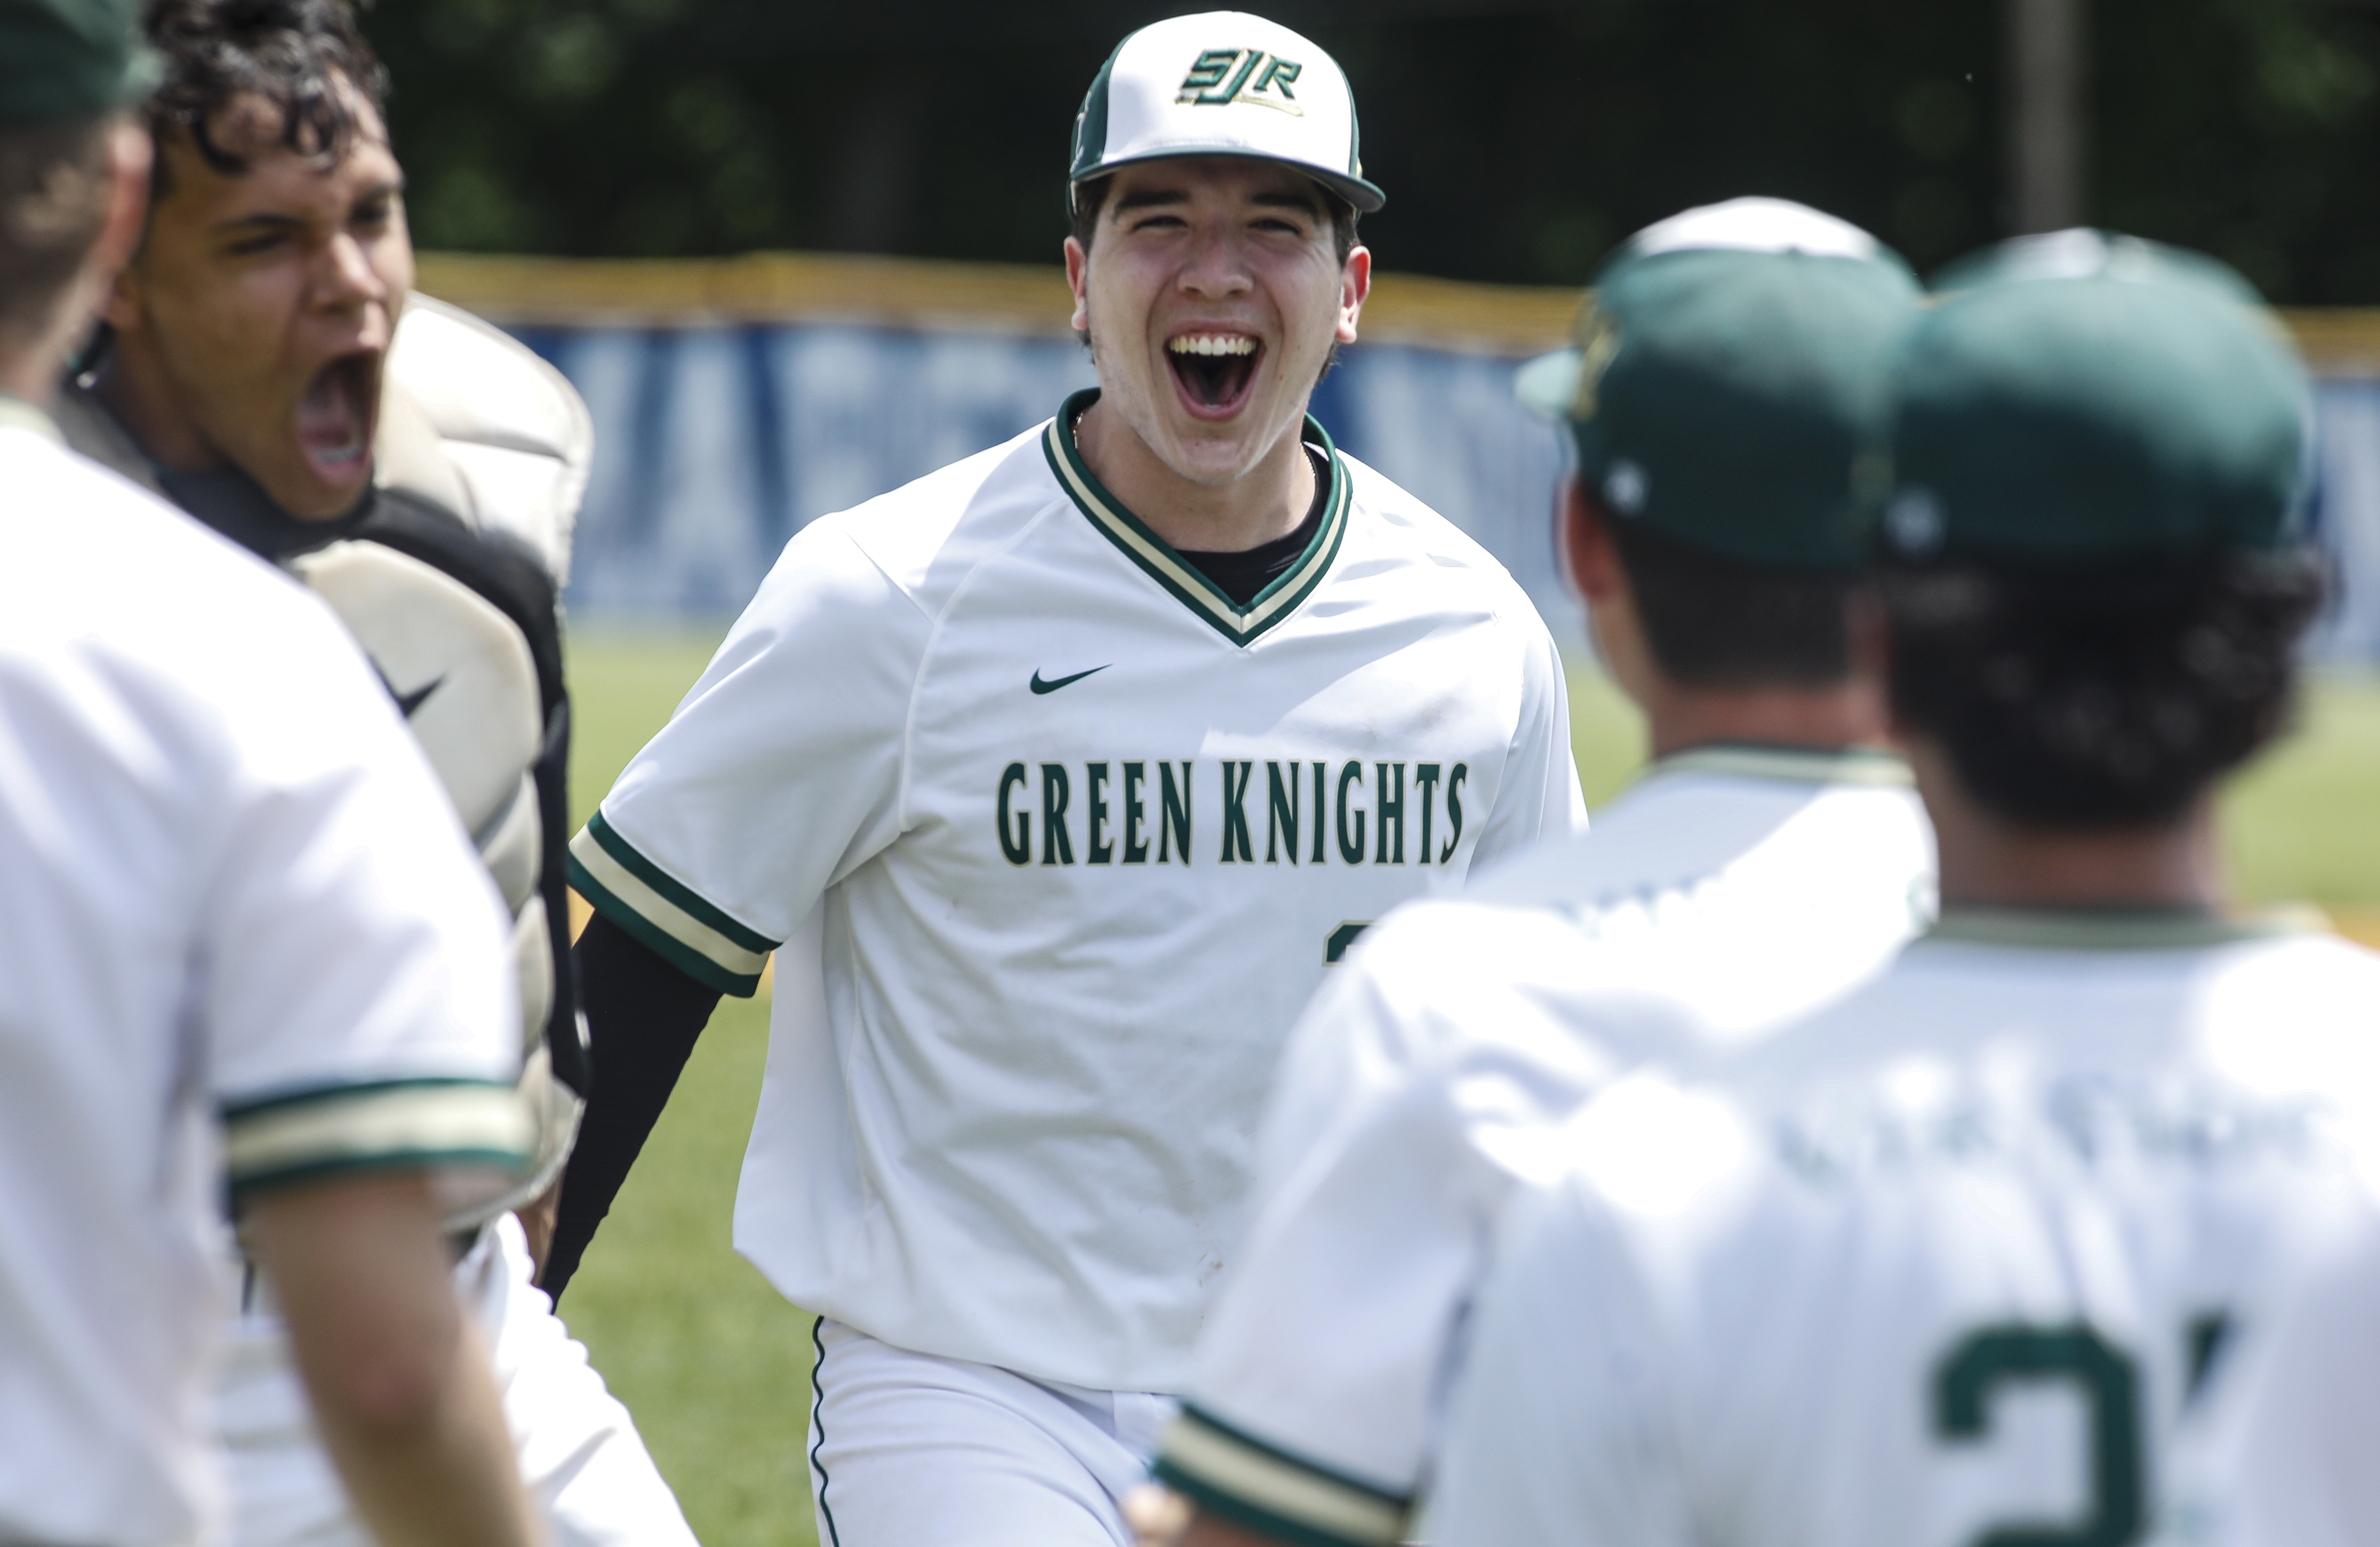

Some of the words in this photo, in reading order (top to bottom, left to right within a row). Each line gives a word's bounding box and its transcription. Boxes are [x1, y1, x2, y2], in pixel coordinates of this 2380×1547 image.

[1180, 47, 1302, 106] SJR
[995, 759, 1195, 868] GREEN
[1217, 757, 1469, 868] KNIGHTS
